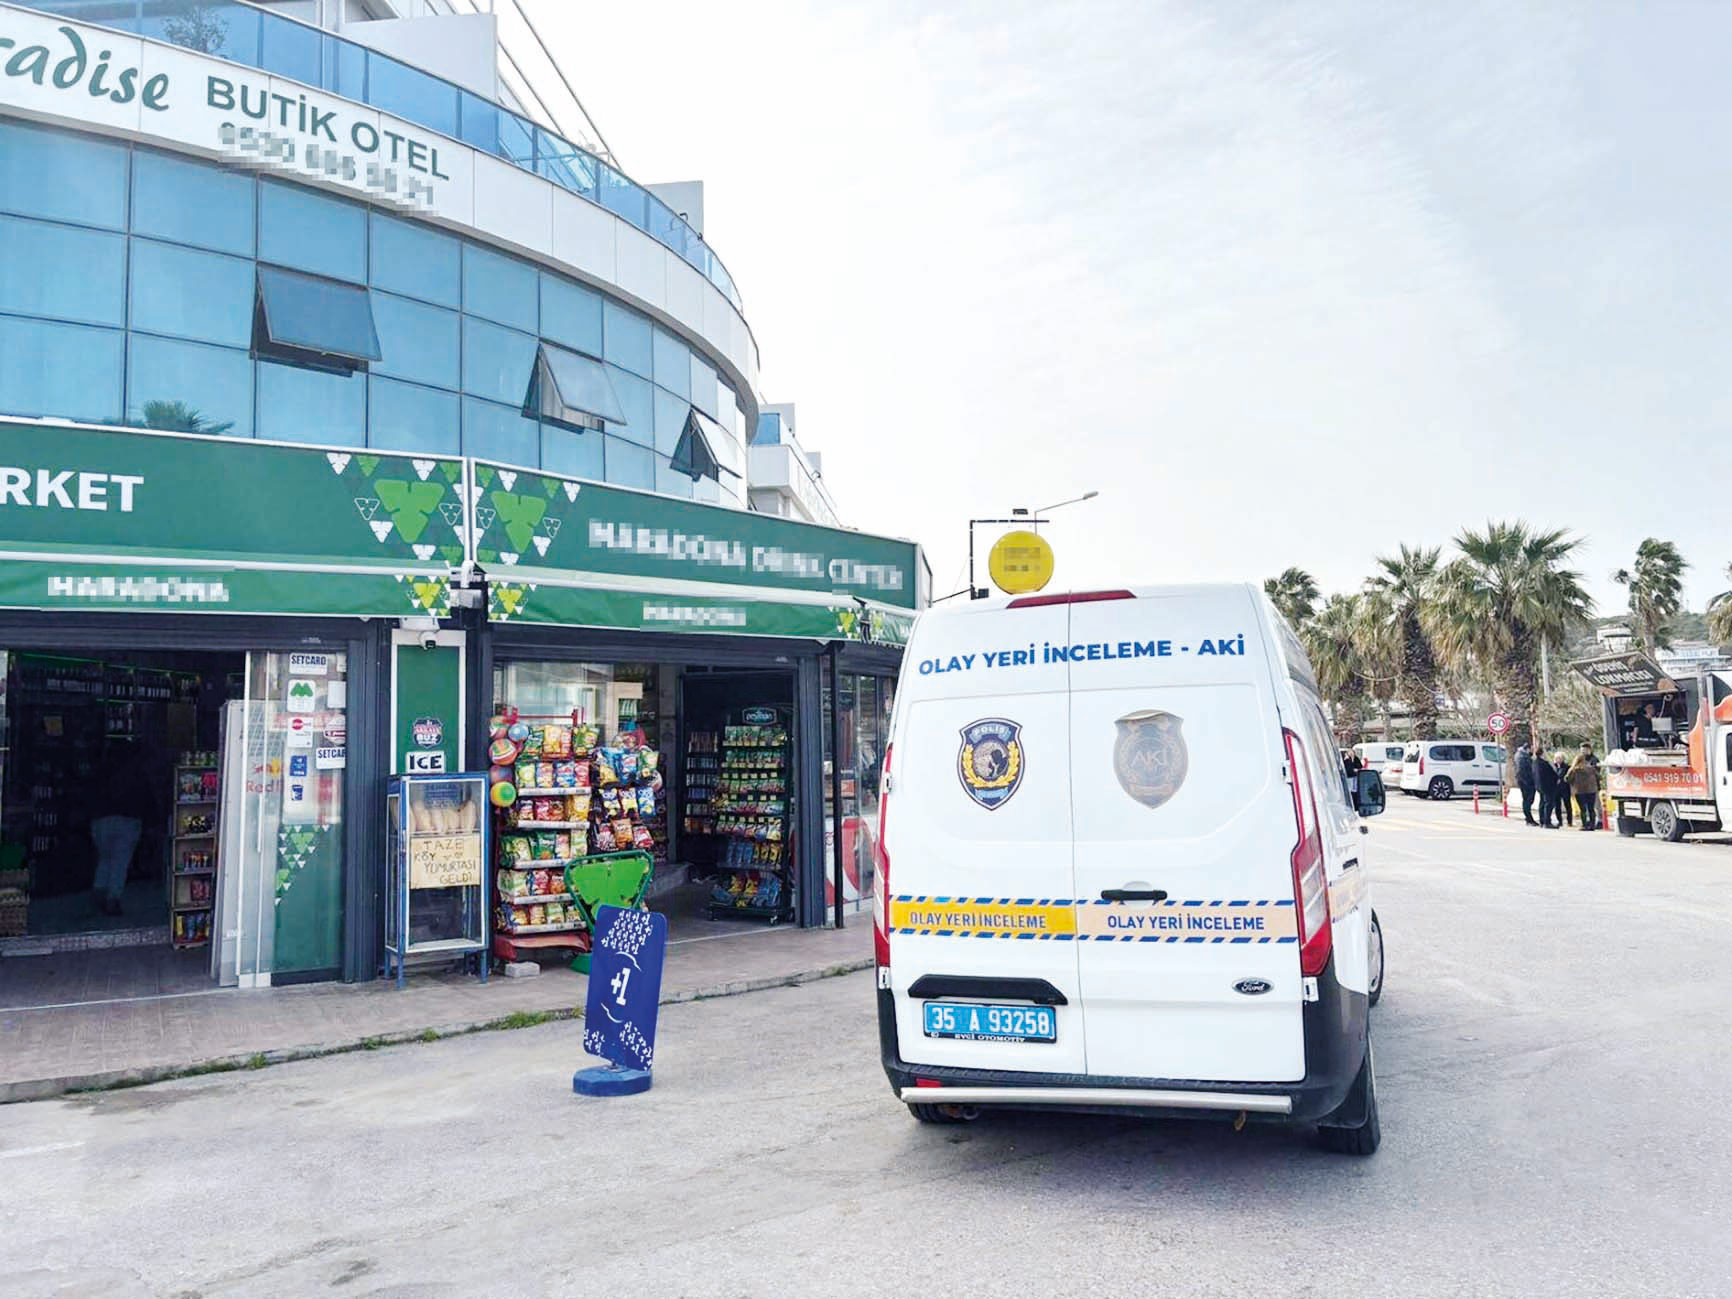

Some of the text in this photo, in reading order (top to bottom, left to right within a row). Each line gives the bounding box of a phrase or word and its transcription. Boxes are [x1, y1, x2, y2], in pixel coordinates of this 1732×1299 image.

[207, 75, 337, 142] BUTİK
[351, 121, 450, 181] OTEL
[0, 466, 145, 513] RKET
[919, 653, 976, 675] OLAY
[983, 643, 1035, 668] YERİ
[1044, 640, 1172, 664] İNCELEME
[1198, 633, 1245, 656] AKİ
[1491, 718, 1505, 728] 50
[409, 754, 442, 770] ICE
[424, 838, 465, 850] TAZE
[910, 911, 1047, 929] OLAY YERİ İNCELEME
[1107, 913, 1265, 930] OLAY YERİ İNCELEME
[610, 967, 631, 1006] +1
[1241, 980, 1266, 992] Ford
[931, 1007, 1050, 1035] 35 A 93258
